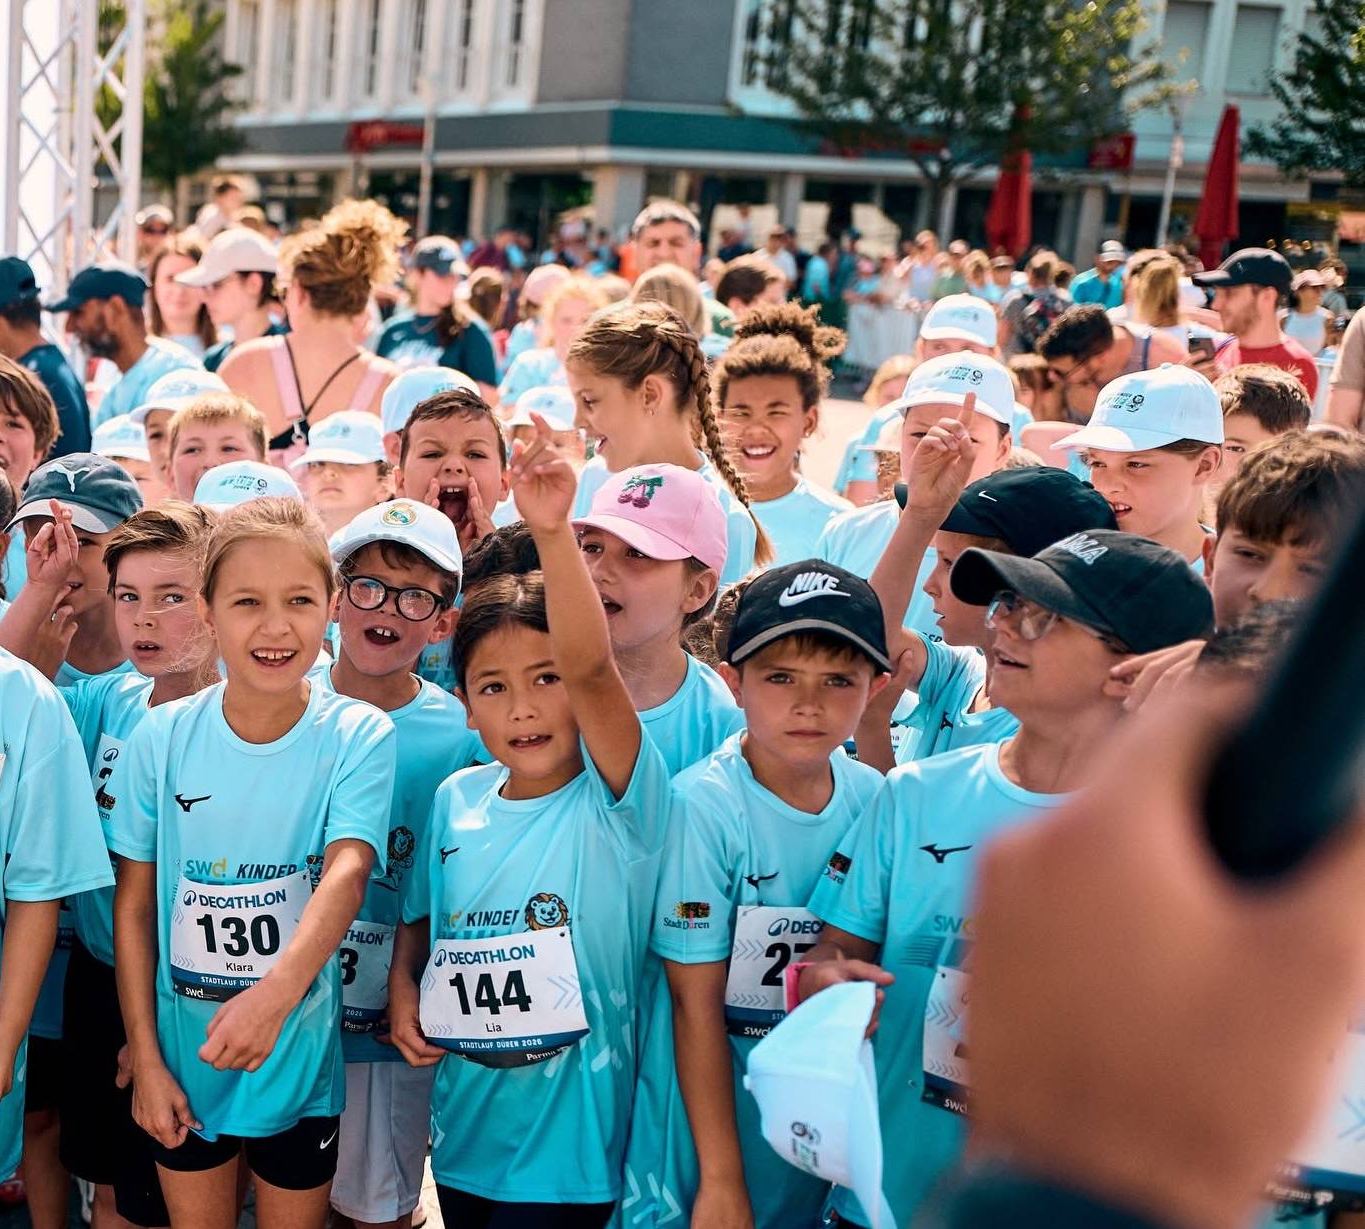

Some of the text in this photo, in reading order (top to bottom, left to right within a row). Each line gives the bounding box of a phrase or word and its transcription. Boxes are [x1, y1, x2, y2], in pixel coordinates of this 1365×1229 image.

[788, 571, 840, 595] NIKE
[198, 889, 287, 909] DECATHLON
[663, 917, 710, 929] Stadt Düren
[196, 913, 281, 957] 130
[344, 929, 384, 946] THLON
[448, 944, 536, 965] DECATHLON
[226, 962, 254, 972] Klara
[339, 947, 359, 985] 3
[201, 976, 237, 986] STADTLAUF
[449, 969, 532, 1015] 144
[485, 1023, 502, 1033] Lia
[459, 1041, 493, 1049] STADTLAUF
[496, 1039, 519, 1048] DÜREN
